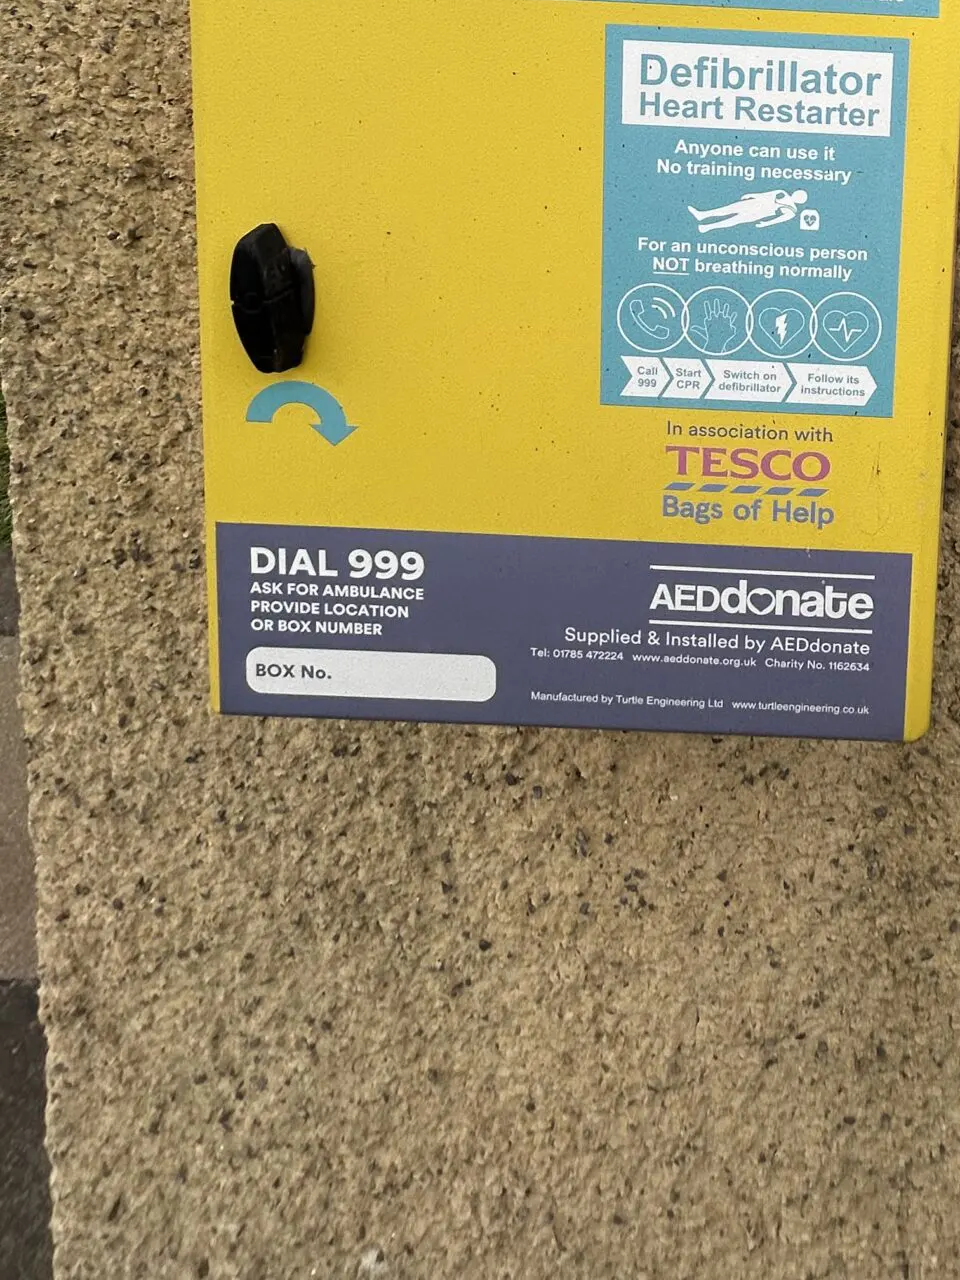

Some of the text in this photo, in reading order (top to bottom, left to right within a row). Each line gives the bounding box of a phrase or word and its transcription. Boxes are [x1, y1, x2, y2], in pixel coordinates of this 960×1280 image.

[640, 53, 882, 96] Defibrillator
[640, 91, 880, 127] Heart Restarter
[674, 139, 835, 160] Anyone can use it
[657, 159, 852, 185] No training necessary
[638, 237, 868, 265] For an unconscious person
[653, 257, 852, 281] NOT breathing normally
[637, 366, 658, 376] Call
[675, 367, 701, 378] Start
[723, 369, 777, 381] Switch on
[808, 373, 859, 385] Follow its
[638, 378, 657, 388] 999
[676, 380, 700, 390] CPR
[719, 382, 781, 393] defibrillator
[801, 385, 866, 398] instructions
[667, 421, 833, 442] In association with
[665, 445, 831, 481] TESCO
[662, 495, 834, 530] Bags of Help
[250, 547, 425, 581] DIAL 999
[250, 582, 424, 600] ASK FOR AMBULANCE
[650, 579, 874, 620] AEDdonate
[251, 600, 409, 618] PROVIDE LOCATION
[251, 619, 383, 636] OR BOX NUMBER
[565, 627, 870, 655] Supplied & Installed by AEDdonate
[530, 647, 869, 671] Tel: 01785 472224 www.aeddonate.org.uk Charity No. 1162634
[256, 664, 332, 680] BOX No.
[531, 691, 869, 715] Manufactured by Turtle Engineering Ltd wwwturtleengineeringcouk
